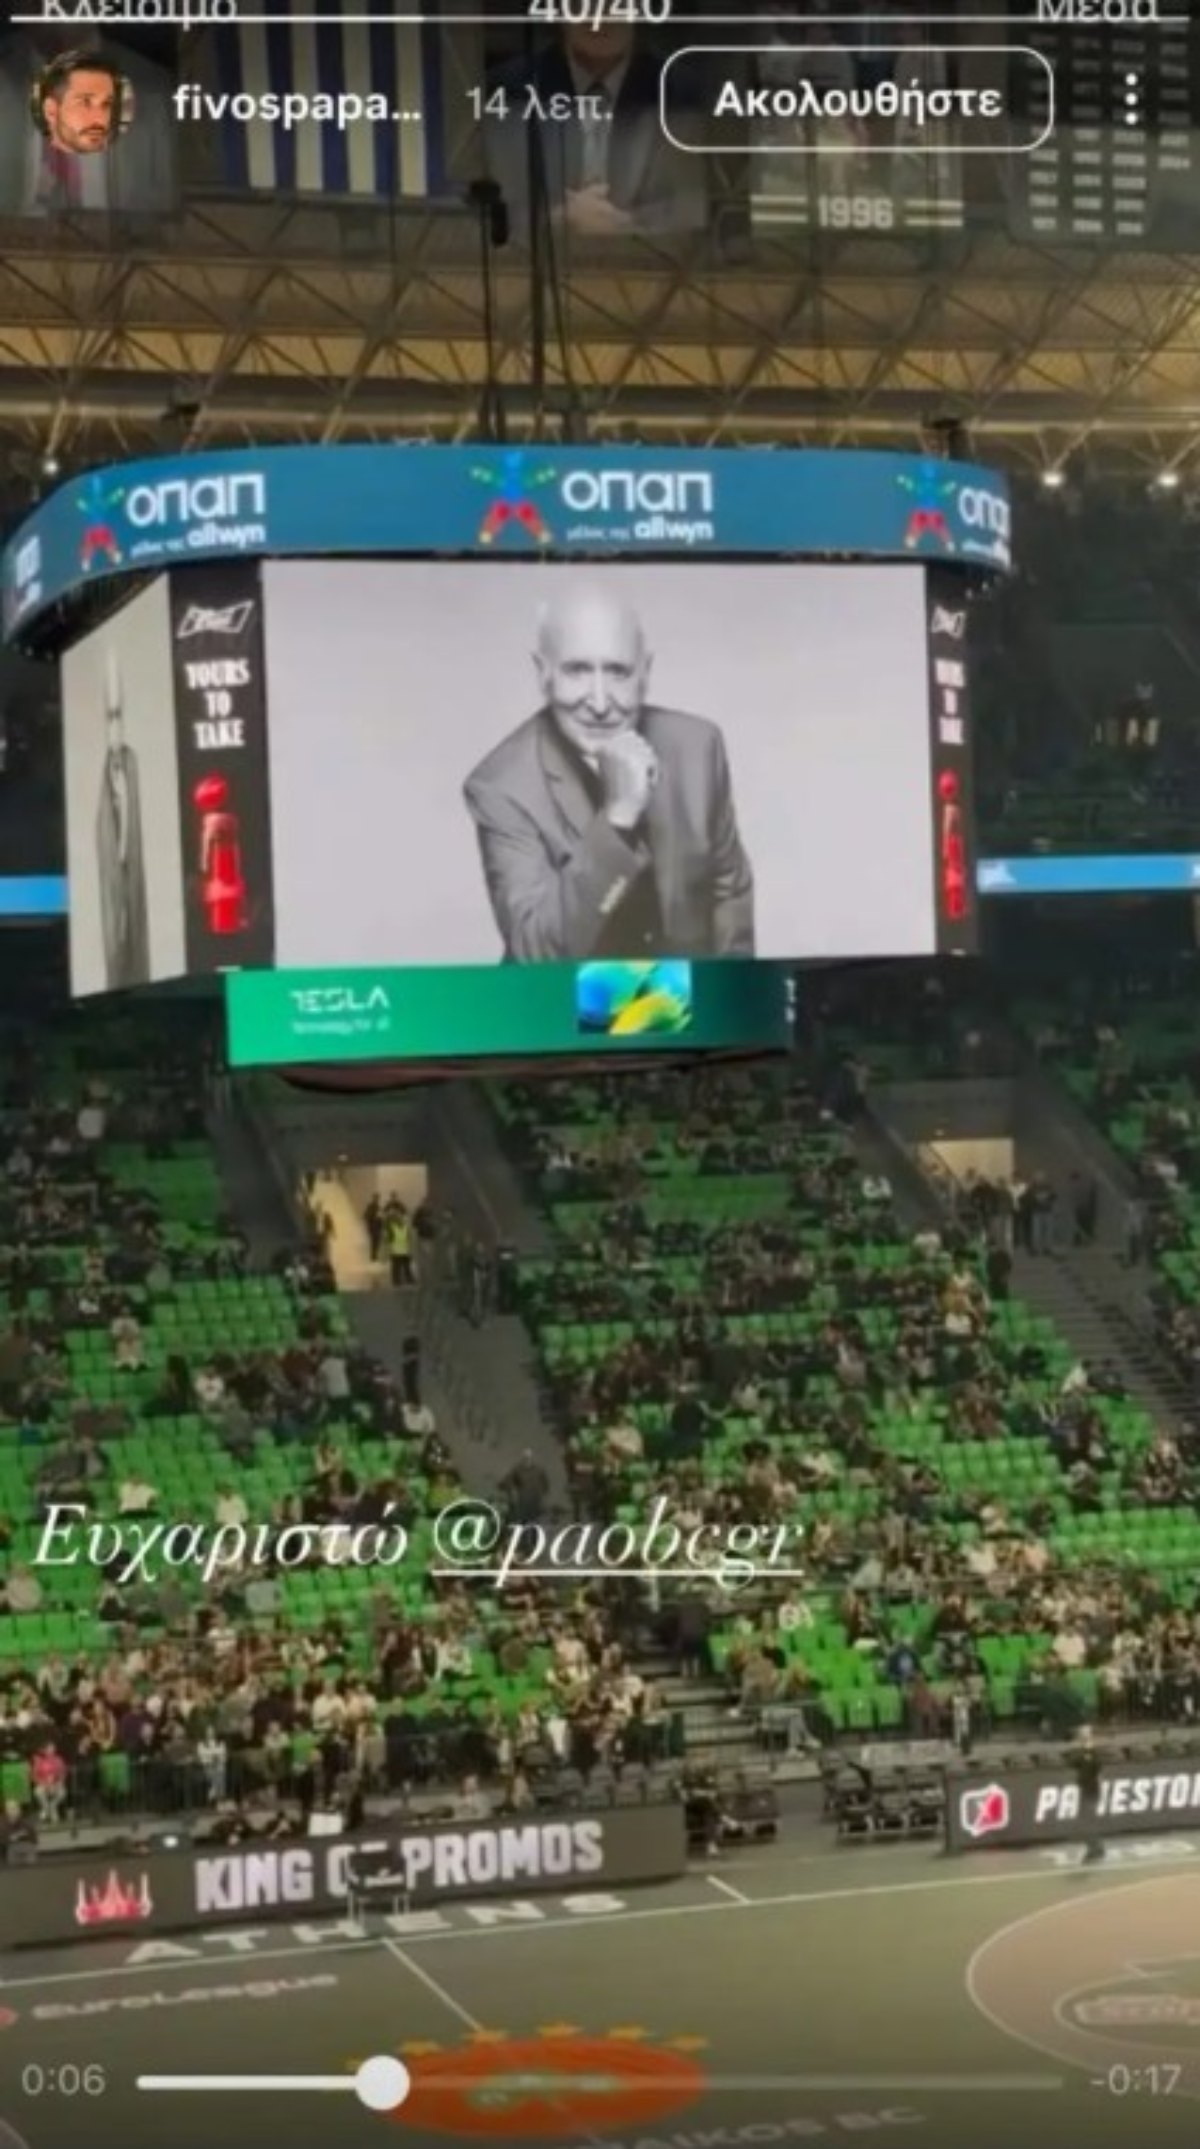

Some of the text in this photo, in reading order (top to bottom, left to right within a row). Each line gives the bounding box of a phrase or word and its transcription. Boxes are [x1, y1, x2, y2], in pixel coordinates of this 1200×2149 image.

[818, 196, 894, 228] 1996
[184, 656, 251, 690] YOURS
[205, 689, 233, 718] TO
[194, 718, 246, 749] TAKE
[290, 985, 391, 1014] TESLA
[195, 1820, 604, 1914] KING O PROMOS
[125, 1892, 627, 1965] ATHENS
